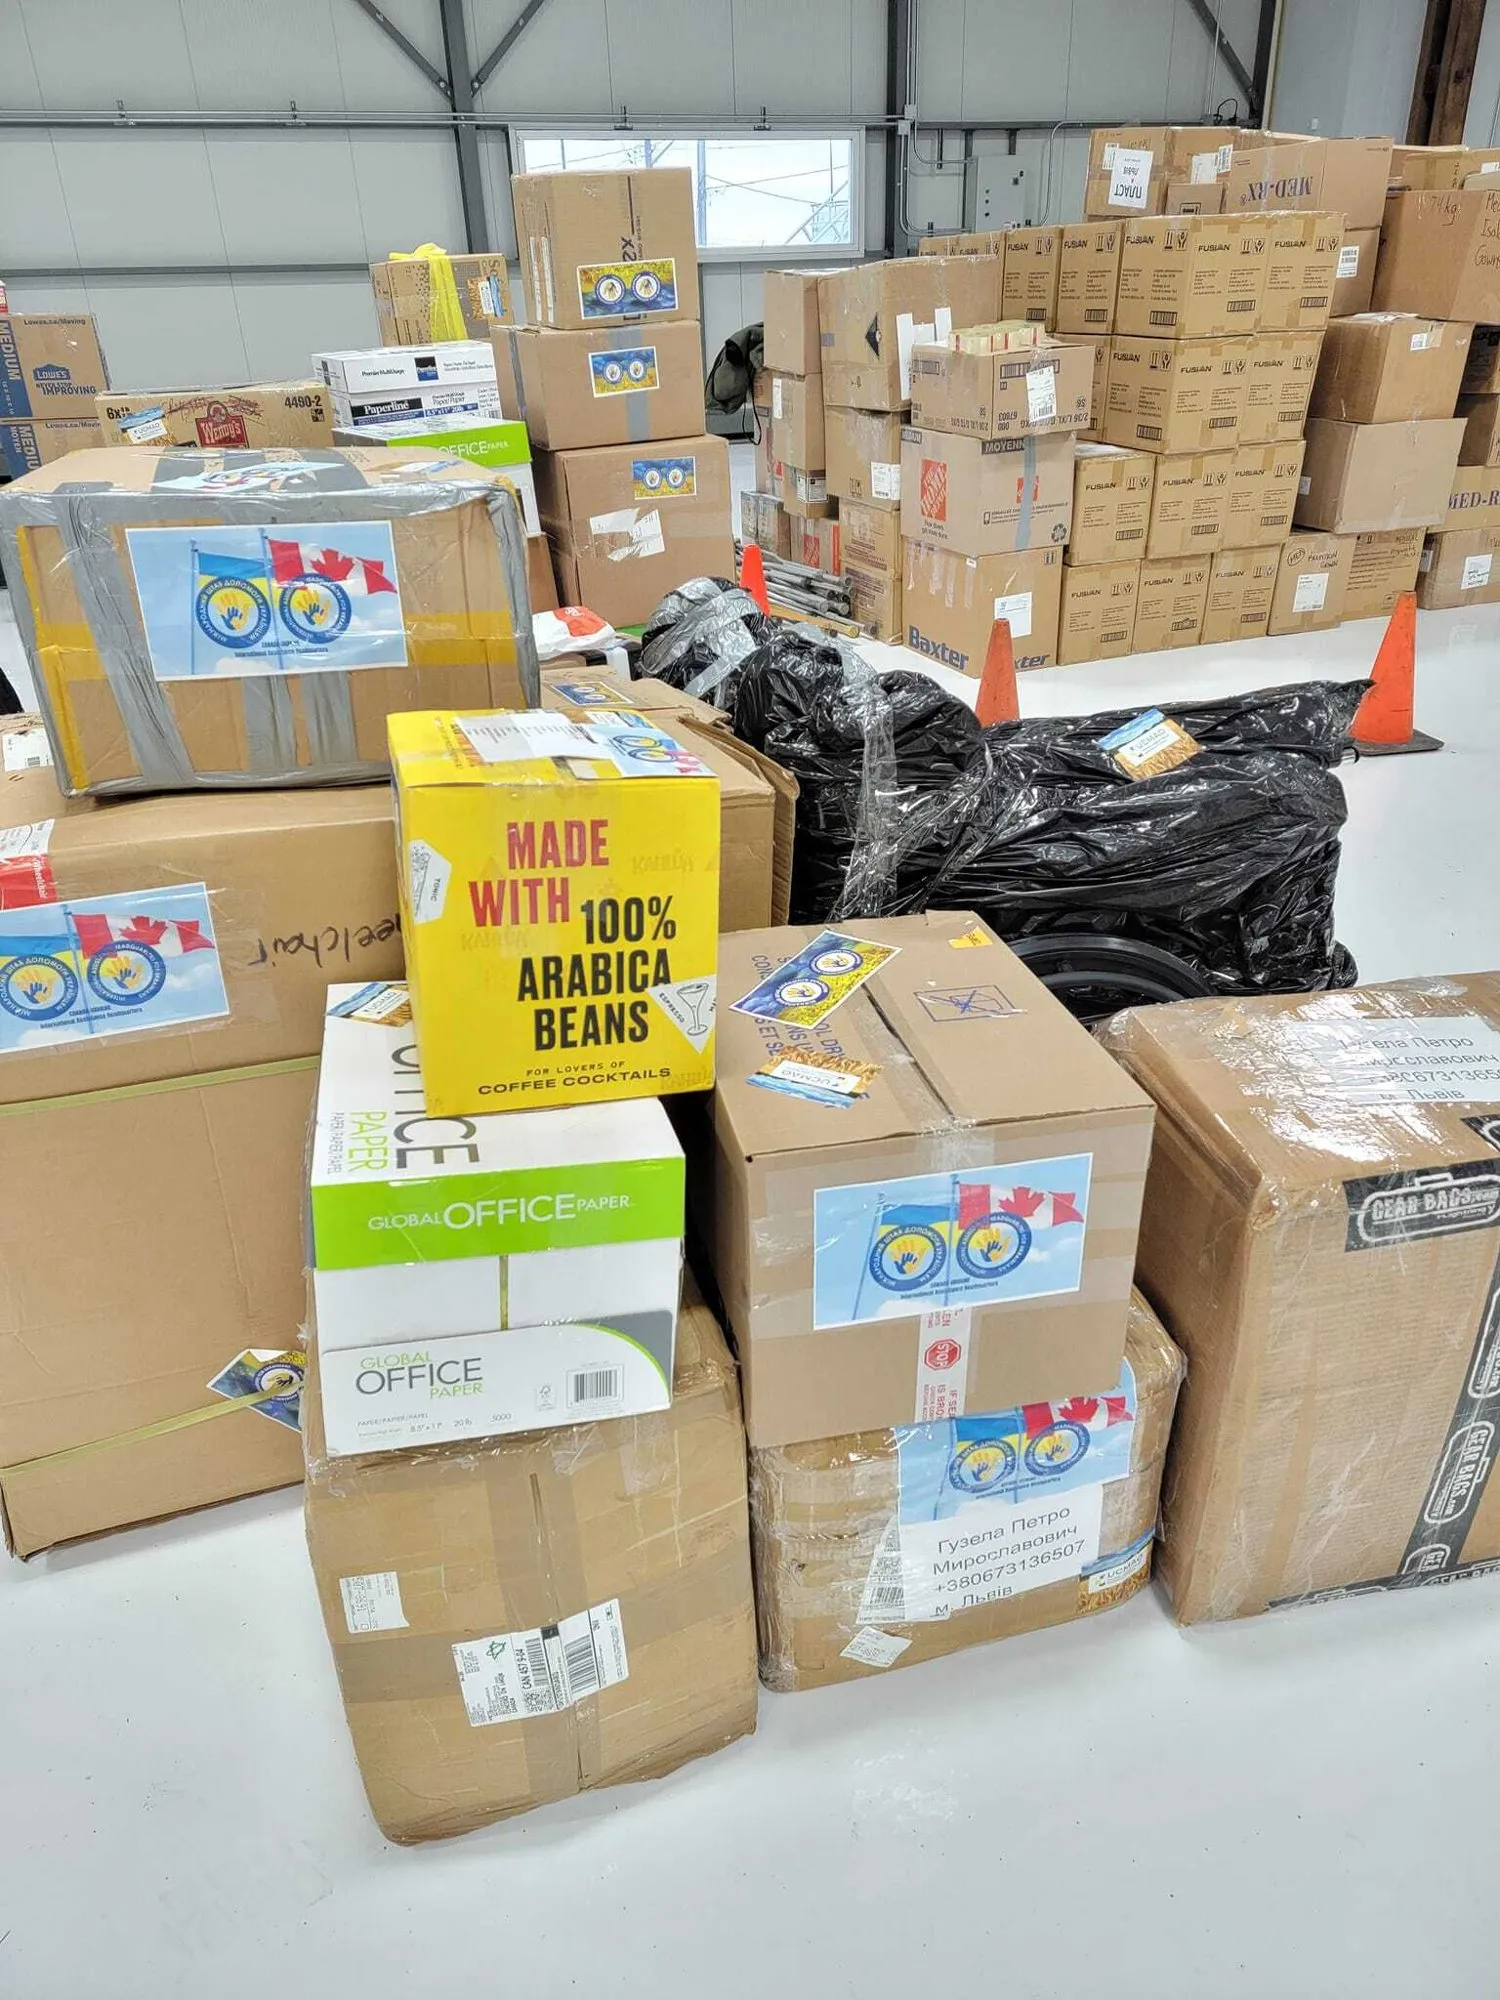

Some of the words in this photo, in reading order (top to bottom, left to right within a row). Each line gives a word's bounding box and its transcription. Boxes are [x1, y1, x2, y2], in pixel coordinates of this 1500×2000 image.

[1114, 184, 1143, 199] ПЛАСТ
[0, 319, 21, 381] MEDIUM
[42, 385, 97, 396] IMPROVING
[364, 400, 409, 414] Paperline
[18, 424, 41, 470] MEDIU
[909, 625, 969, 671] Baxter
[507, 819, 609, 869] MADE
[430, 878, 441, 903] TONIC
[468, 877, 570, 927] WITH
[581, 895, 677, 945] 100%
[517, 948, 672, 1002] ARABICA
[533, 1001, 649, 1051] BEANS
[1412, 1037, 1474, 1050] Петро
[478, 1078, 557, 1096] COFFEE
[562, 1066, 671, 1087] COCKTAILS
[526, 1067, 550, 1077] FOR
[556, 1062, 604, 1075] LOVERS
[611, 1060, 626, 1070] OF
[1407, 1088, 1466, 1100] Львів
[348, 1110, 389, 1172] PAPER
[368, 1211, 443, 1231] GLOBAL
[442, 1193, 576, 1230] OFFICE
[576, 1194, 632, 1211] PAPER
[1372, 1195, 1418, 1221] GEAR
[1424, 1187, 1471, 1212] BAGS
[355, 1357, 483, 1395] OFFICE
[360, 1350, 432, 1369] GLOBAL
[430, 1381, 483, 1400] PAPER
[1463, 1428, 1488, 1464] GEAR
[1450, 1463, 1476, 1499] BAGS
[937, 1525, 1005, 1554] Гузела
[1011, 1506, 1071, 1536] Петро
[932, 1525, 1078, 1576] Мирославович
[934, 1540, 1086, 1594] +380673136507
[960, 1584, 1013, 1609] Львів
